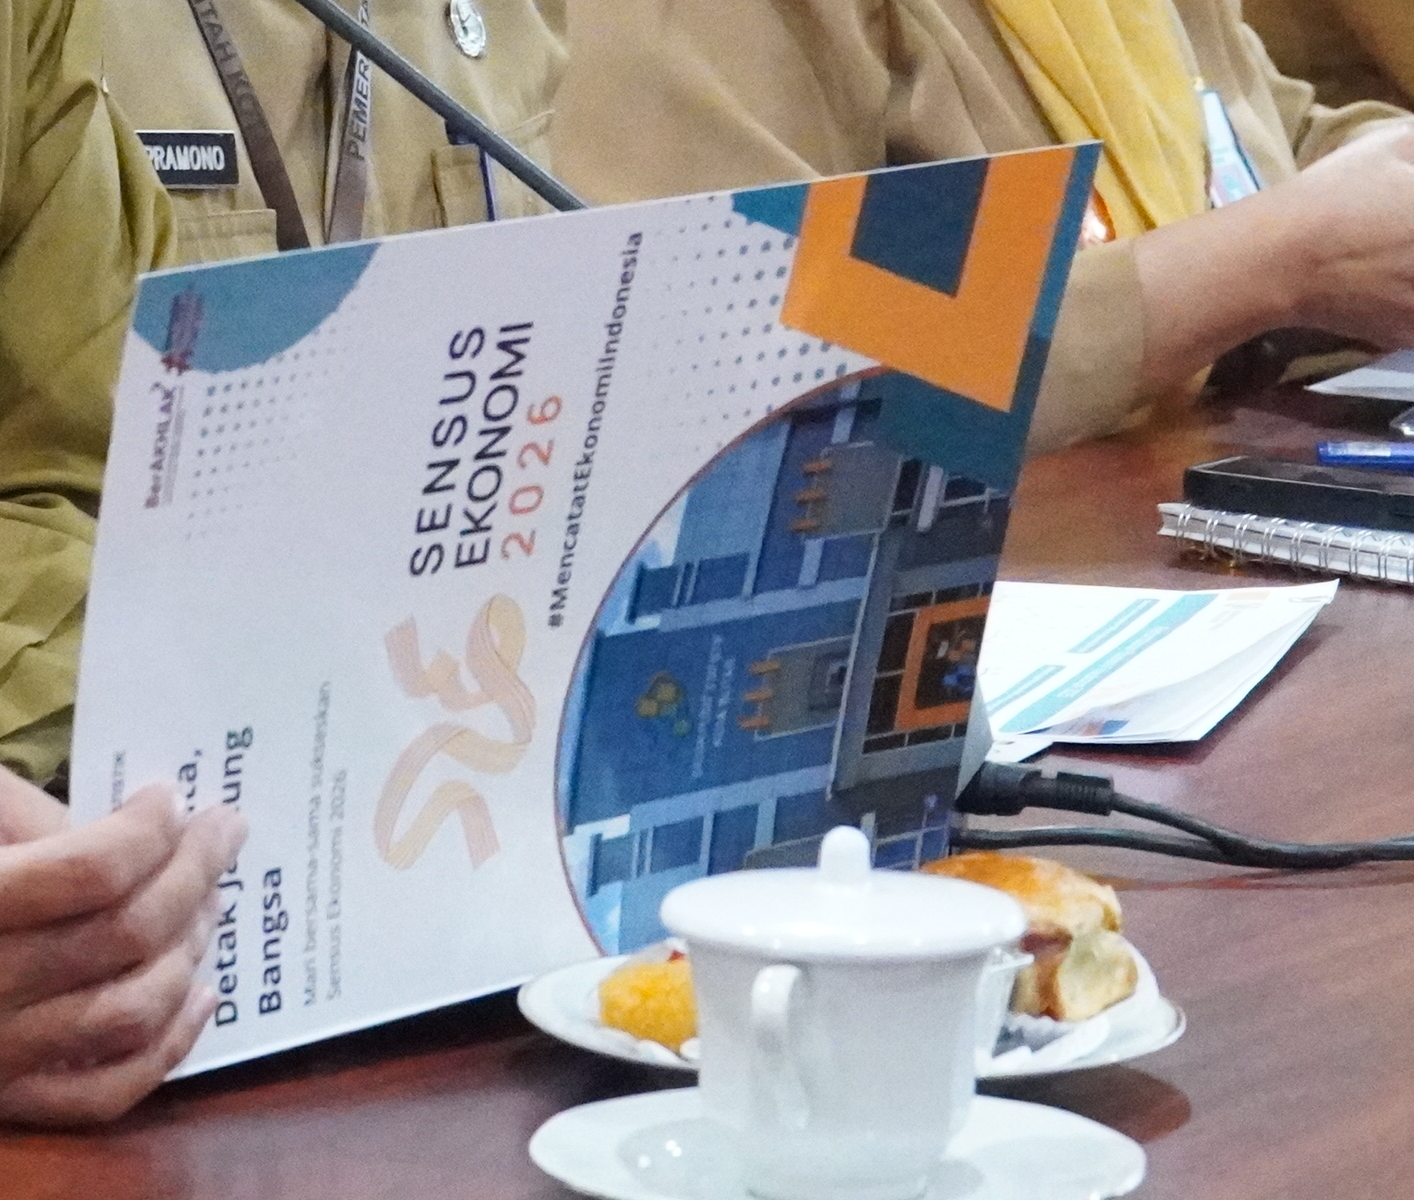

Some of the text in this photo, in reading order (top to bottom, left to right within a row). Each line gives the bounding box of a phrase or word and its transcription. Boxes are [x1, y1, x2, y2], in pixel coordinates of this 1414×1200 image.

[409, 326, 485, 577] SENSUS
[454, 321, 534, 568] EKONOMI
[499, 395, 563, 560] 2026
[547, 231, 643, 629] #MencatatEkonomiIndonesia
[215, 899, 238, 1027] Detak
[258, 866, 289, 1016] Bangsa
